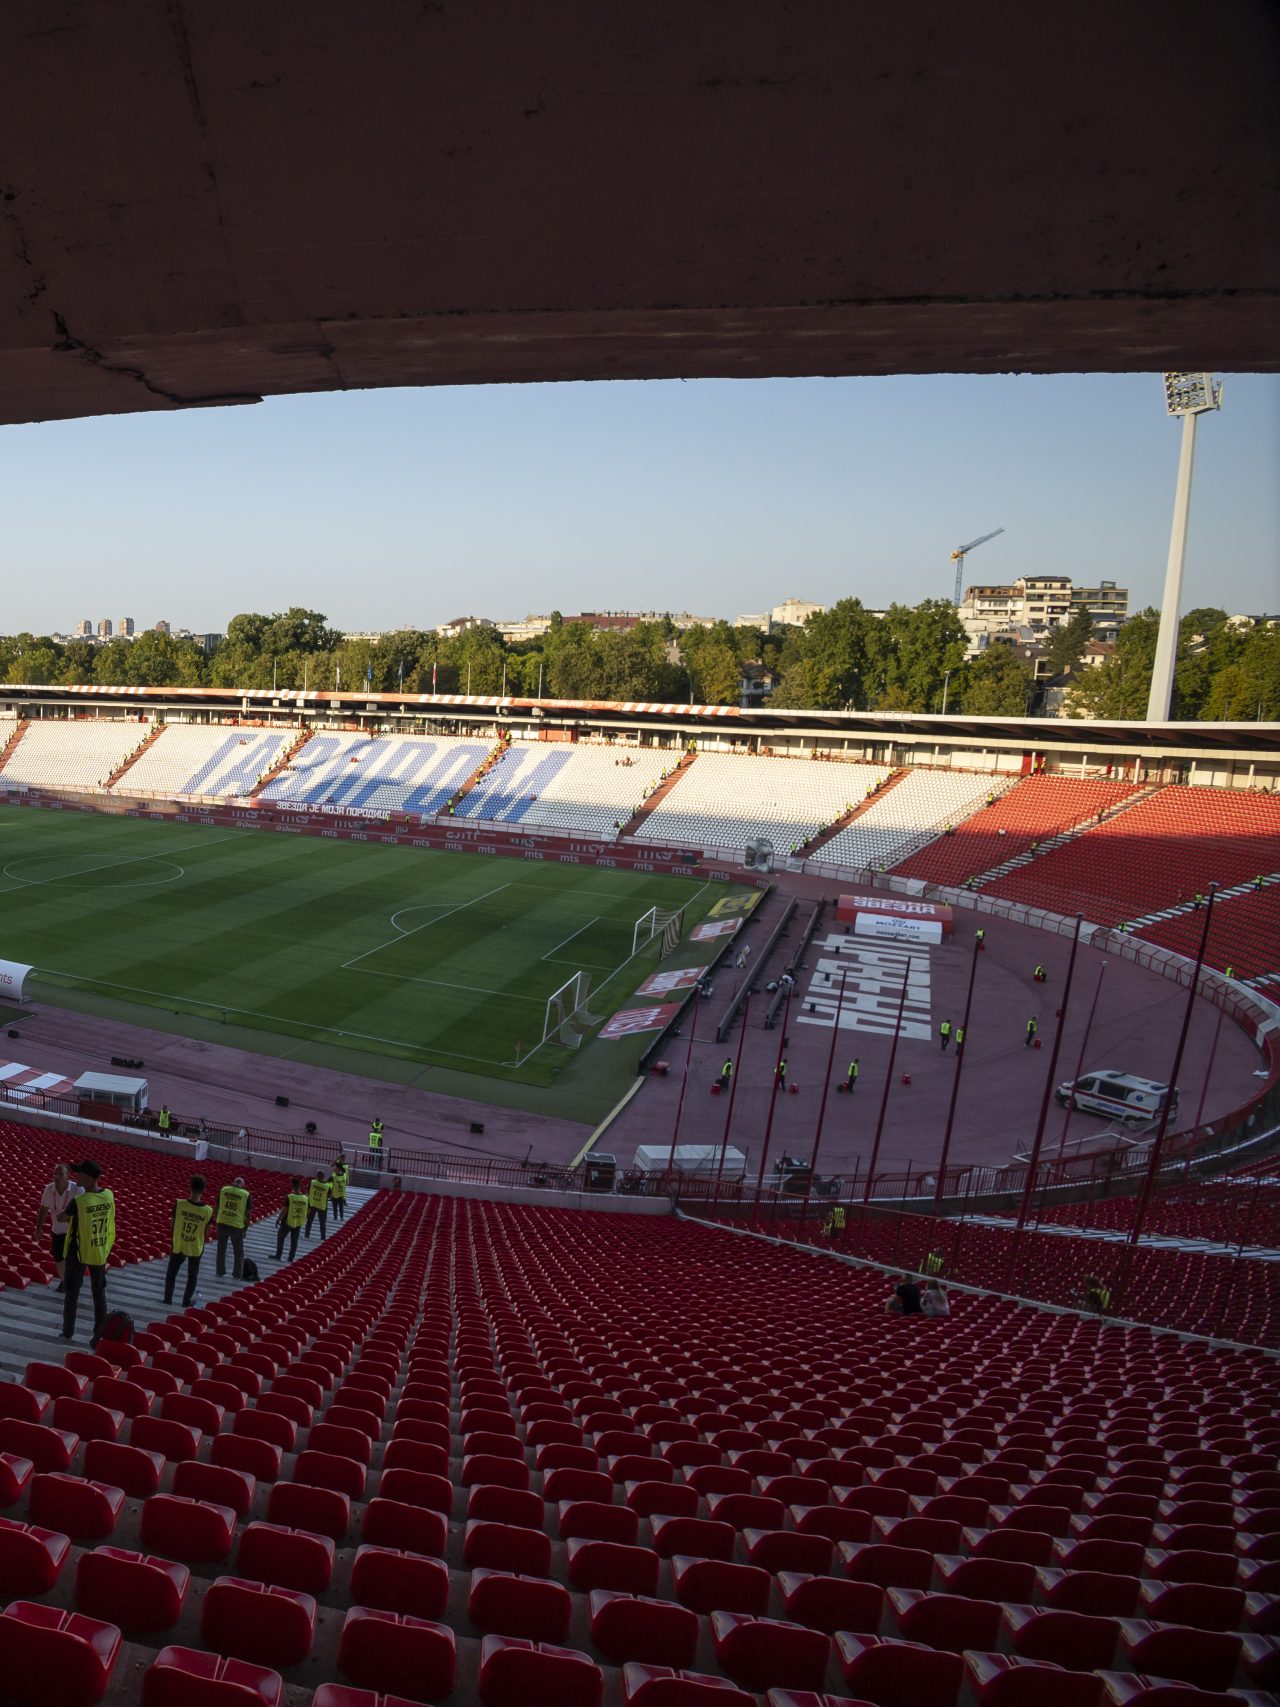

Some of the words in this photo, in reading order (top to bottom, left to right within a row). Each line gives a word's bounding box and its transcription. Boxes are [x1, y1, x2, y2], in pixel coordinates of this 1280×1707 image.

[181, 733, 574, 823] ГАЗПРОМ
[276, 801, 307, 812] ЗВЕЗДА
[309, 804, 320, 813] ЈЕ
[321, 805, 344, 815] МОЈА
[201, 817, 214, 825] mts
[381, 836, 398, 844] mts
[413, 839, 430, 847] mts
[445, 842, 463, 851] mts
[478, 845, 496, 854] mts
[525, 851, 544, 859] mts
[560, 854, 579, 863] mts
[596, 858, 616, 867] mts
[633, 862, 654, 871] mts
[672, 866, 693, 875] mts
[710, 871, 730, 880] mts
[853, 896, 936, 915] ЗВЕЗДА
[875, 921, 921, 931] MOZZART
[183, 1221, 198, 1234] 157
